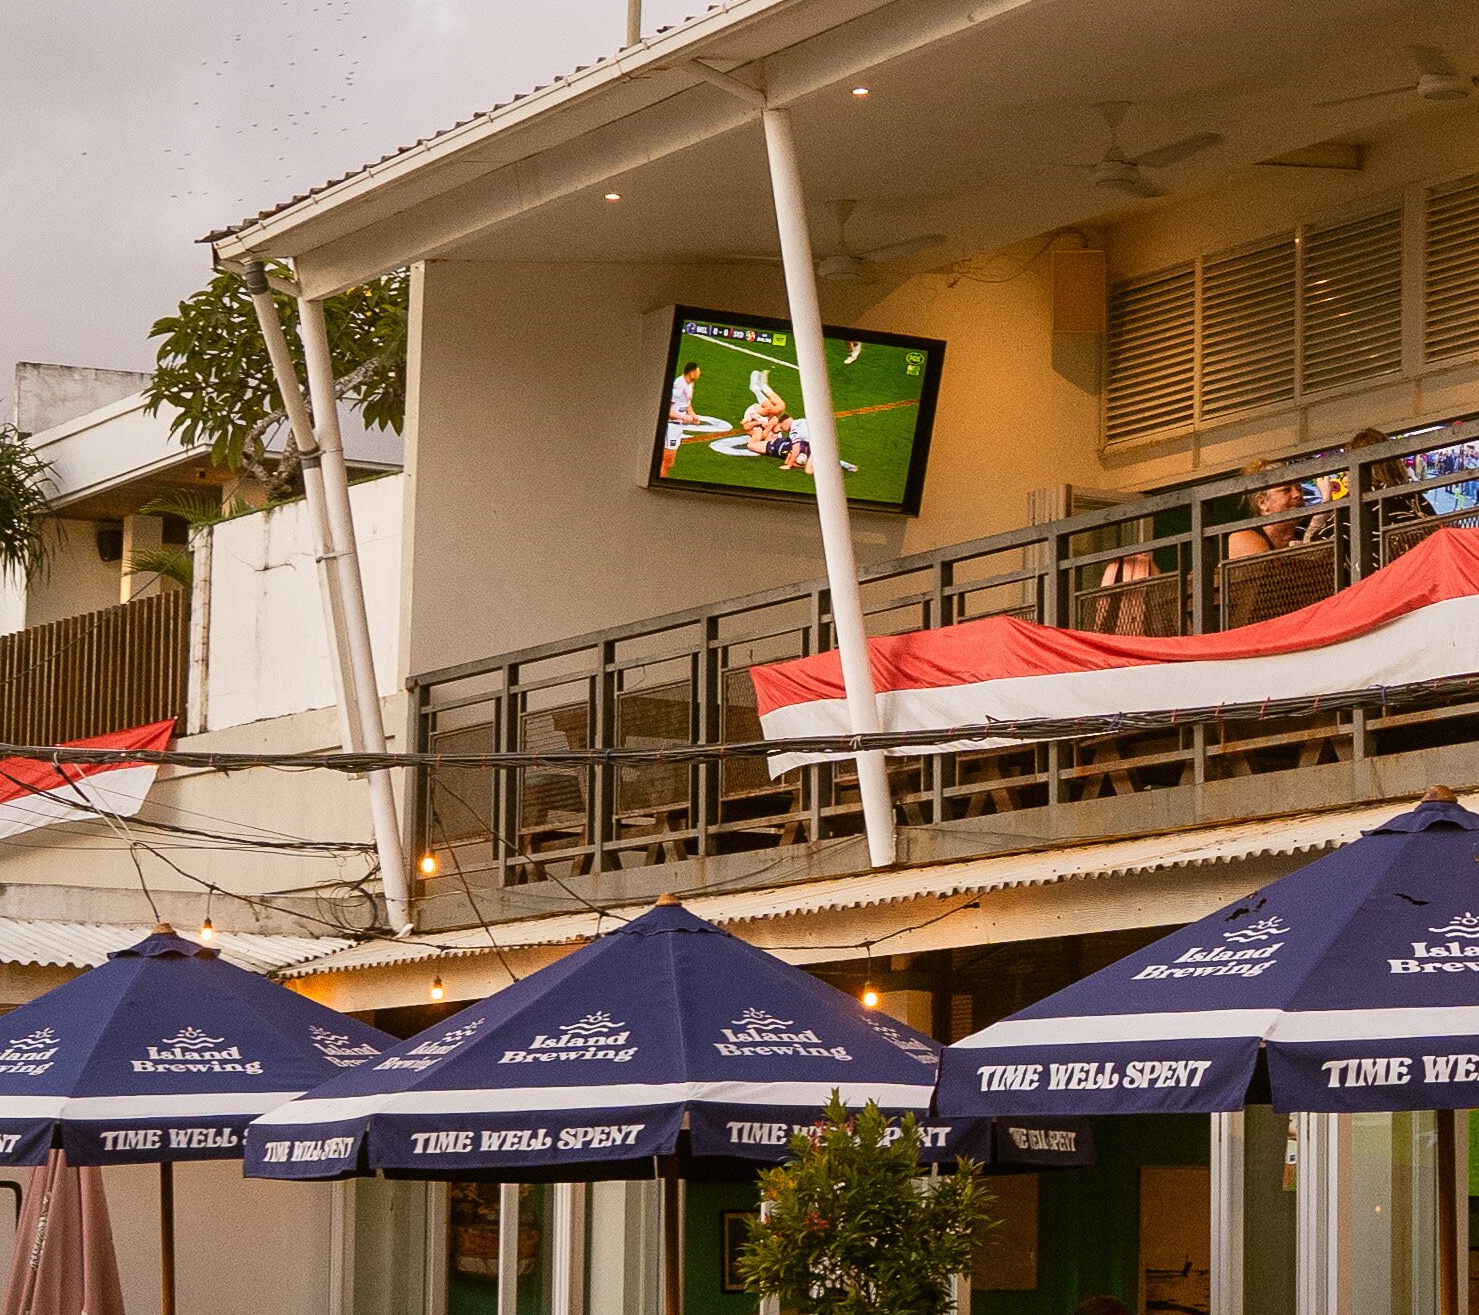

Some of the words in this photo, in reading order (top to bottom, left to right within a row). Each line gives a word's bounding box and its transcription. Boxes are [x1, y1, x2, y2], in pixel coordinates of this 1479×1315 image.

[1175, 942, 1286, 964] Island
[1131, 958, 1274, 981] Brewing
[529, 1030, 632, 1051] Island
[721, 1027, 823, 1045] Island
[148, 1046, 241, 1062] Island
[497, 1047, 640, 1066] Brewing
[713, 1042, 854, 1063] Brewing
[132, 1059, 264, 1077] Brewing
[976, 1064, 1044, 1093] TIME
[1047, 1062, 1120, 1091] WELL
[1121, 1059, 1213, 1089] SPENT
[1320, 1056, 1413, 1089] TIME
[99, 1130, 165, 1151] TIME
[168, 1128, 241, 1150] WELL
[410, 1130, 474, 1155] TIME
[479, 1128, 554, 1152] WELL
[558, 1123, 646, 1150] SPENT
[726, 1121, 788, 1145] TIME
[319, 1137, 356, 1161] SENT
